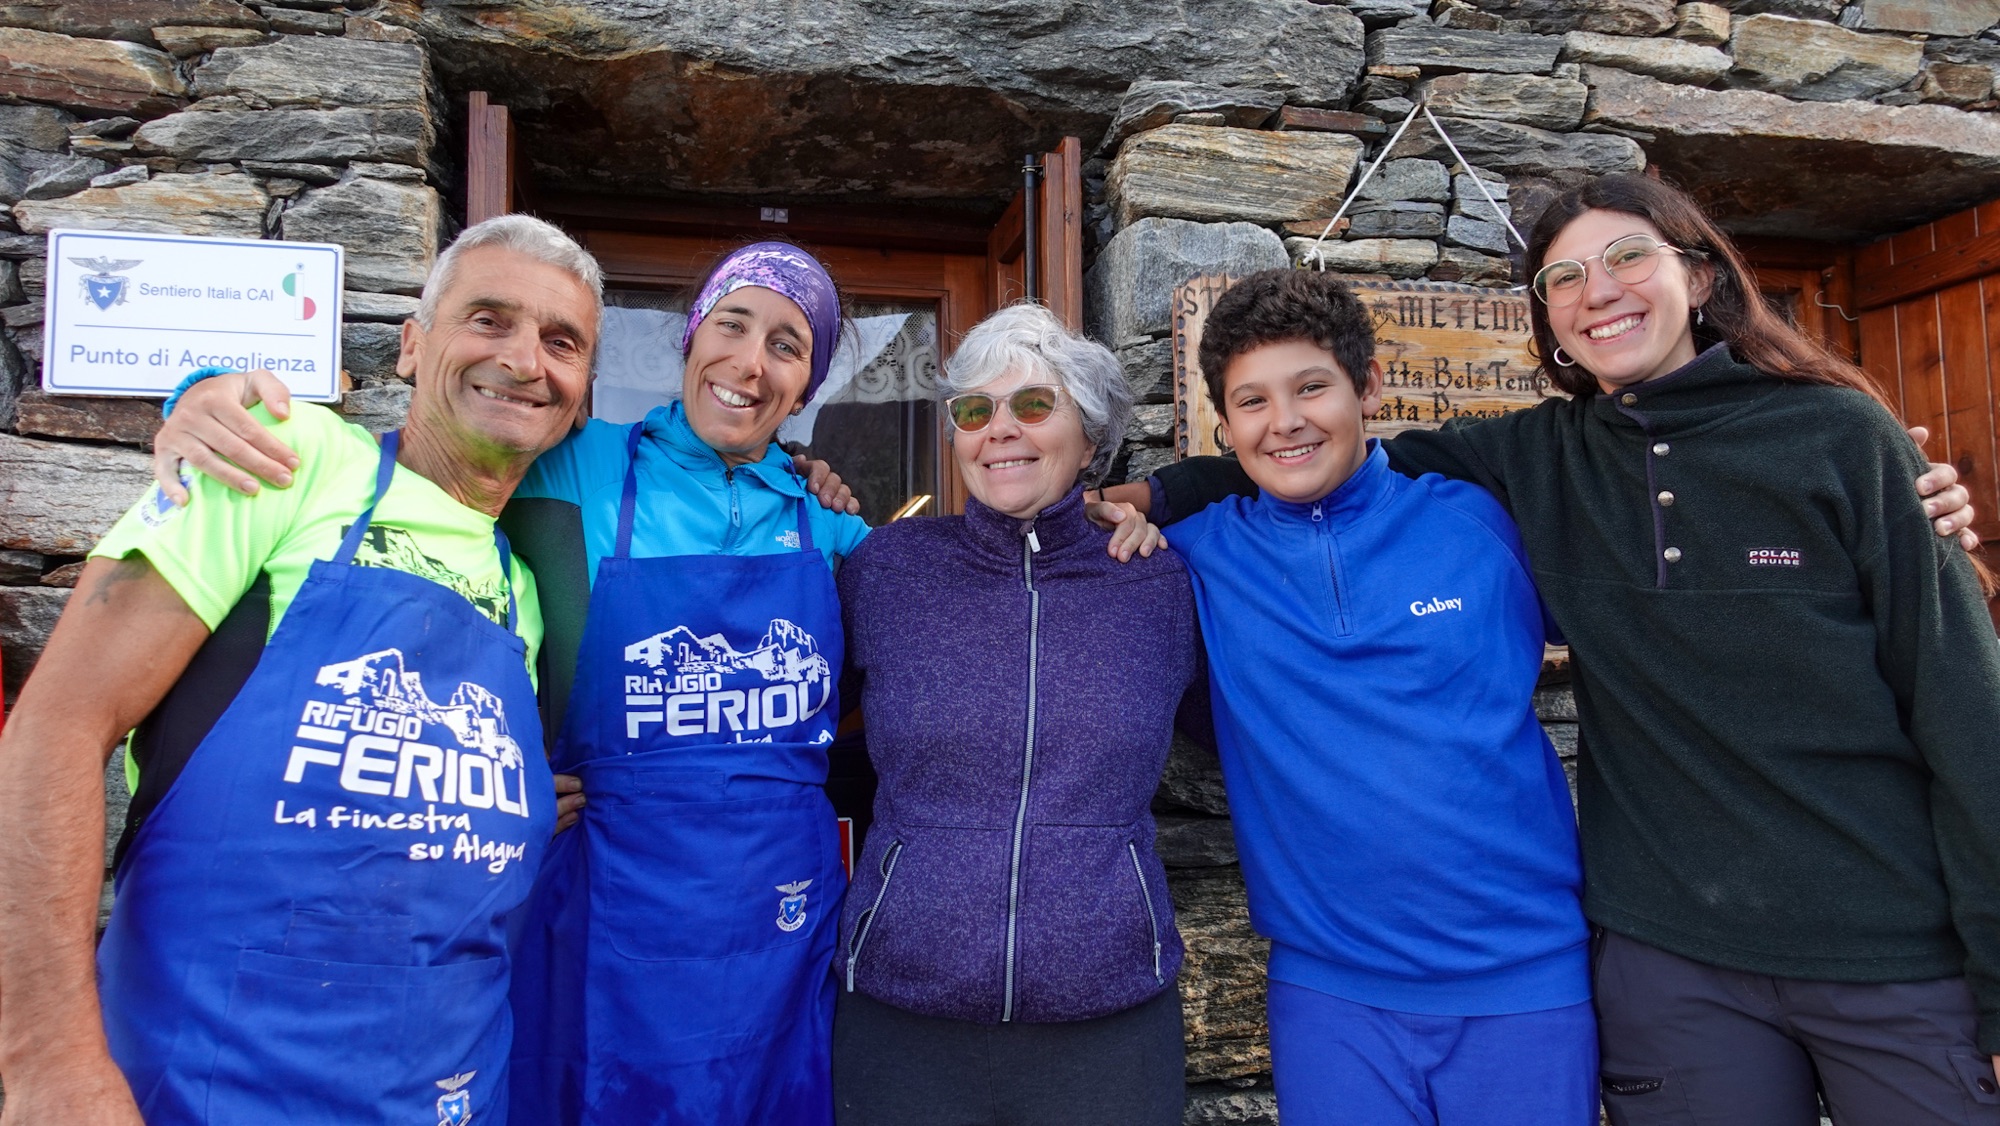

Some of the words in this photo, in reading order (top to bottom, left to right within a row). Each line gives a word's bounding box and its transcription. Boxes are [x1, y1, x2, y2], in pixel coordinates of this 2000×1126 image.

[139, 282, 202, 298] Sentiero
[207, 285, 242, 299] Italia
[246, 287, 274, 301] CAI
[1397, 294, 1530, 334] METEOR
[70, 344, 138, 366] Punto
[148, 347, 169, 367] di
[178, 348, 317, 373] Accoglienza
[1432, 356, 1473, 390] Bel
[1487, 358, 1550, 392] Temp
[1749, 550, 1799, 558] POLAR
[1749, 558, 1800, 566] CRUISE
[301, 700, 422, 741] RIFUGIO
[624, 675, 831, 739] FERIOLI
[283, 724, 529, 818] FERIOLI
[274, 800, 316, 828] La
[327, 804, 471, 833] finestra
[409, 842, 444, 860] su
[452, 832, 526, 874] Alagna
